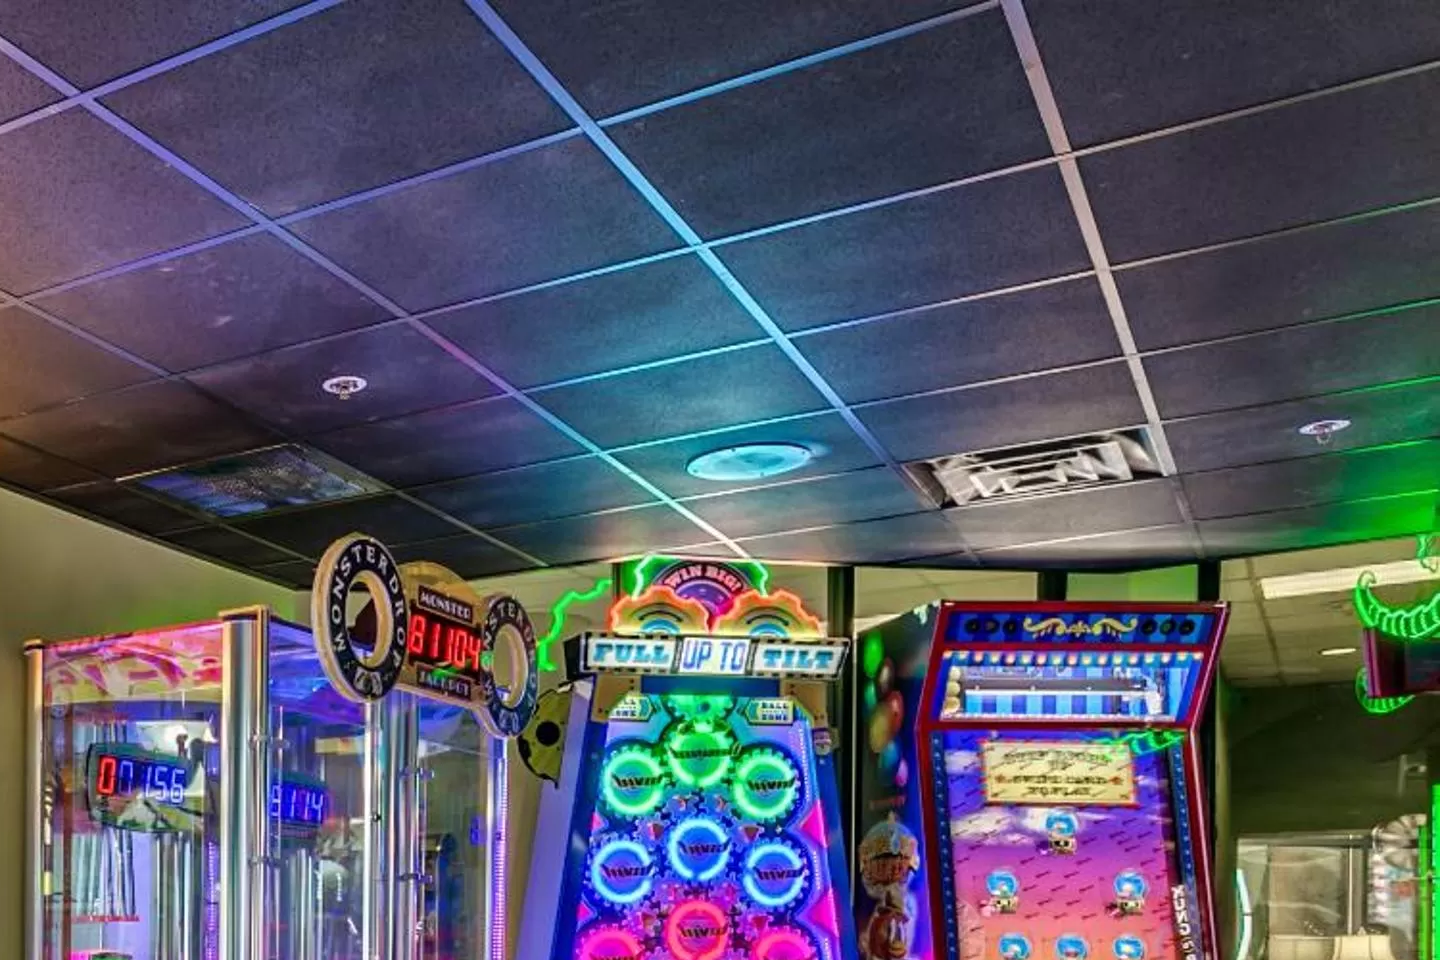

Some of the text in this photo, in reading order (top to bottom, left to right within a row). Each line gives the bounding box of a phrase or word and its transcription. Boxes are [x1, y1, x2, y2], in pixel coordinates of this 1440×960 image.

[664, 564, 701, 588] WIN
[593, 641, 835, 671] FULL UP TO TILT
